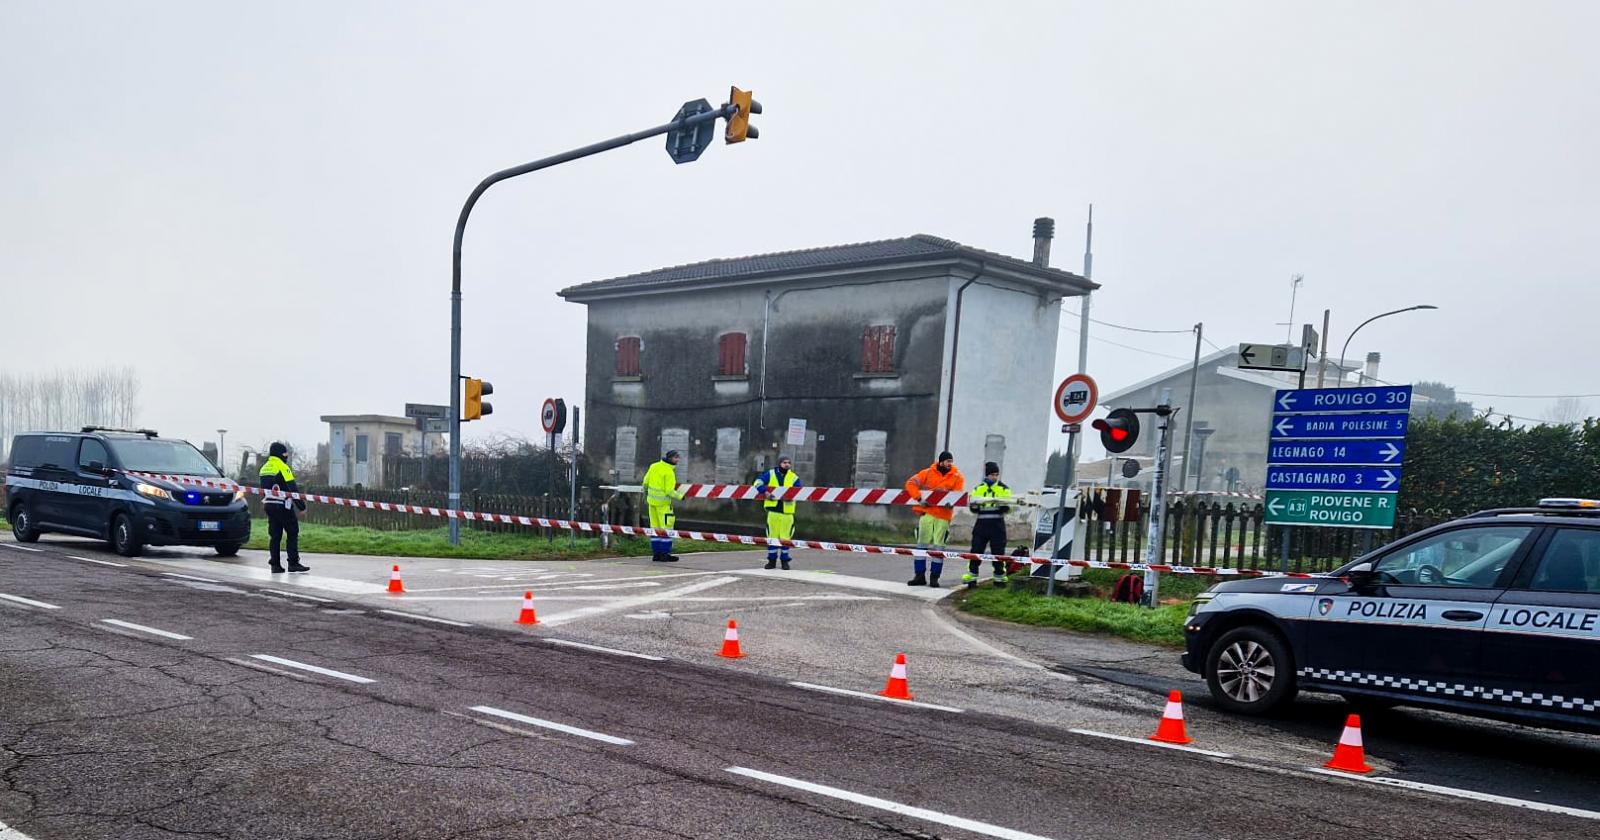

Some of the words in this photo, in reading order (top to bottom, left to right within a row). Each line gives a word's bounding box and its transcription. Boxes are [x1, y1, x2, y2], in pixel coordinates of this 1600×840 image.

[1314, 393, 1376, 405] ROVIGO
[1386, 392, 1407, 404] 30
[1306, 421, 1335, 431] BADIA
[1342, 420, 1388, 430] POLESINE
[1396, 420, 1403, 429] 5
[1272, 446, 1324, 458] LEGNAGO
[1334, 446, 1346, 457] 14
[1270, 472, 1346, 484] CASTAGNARO
[1354, 474, 1363, 485] 3
[79, 486, 102, 497] LOCALE
[1289, 503, 1295, 512] A
[1311, 495, 1372, 508] PIOVENE
[1377, 497, 1391, 508] R.
[1309, 510, 1363, 522] ROVIGO
[1347, 601, 1428, 620] POLIZIA
[1498, 608, 1599, 631] LOCALE
